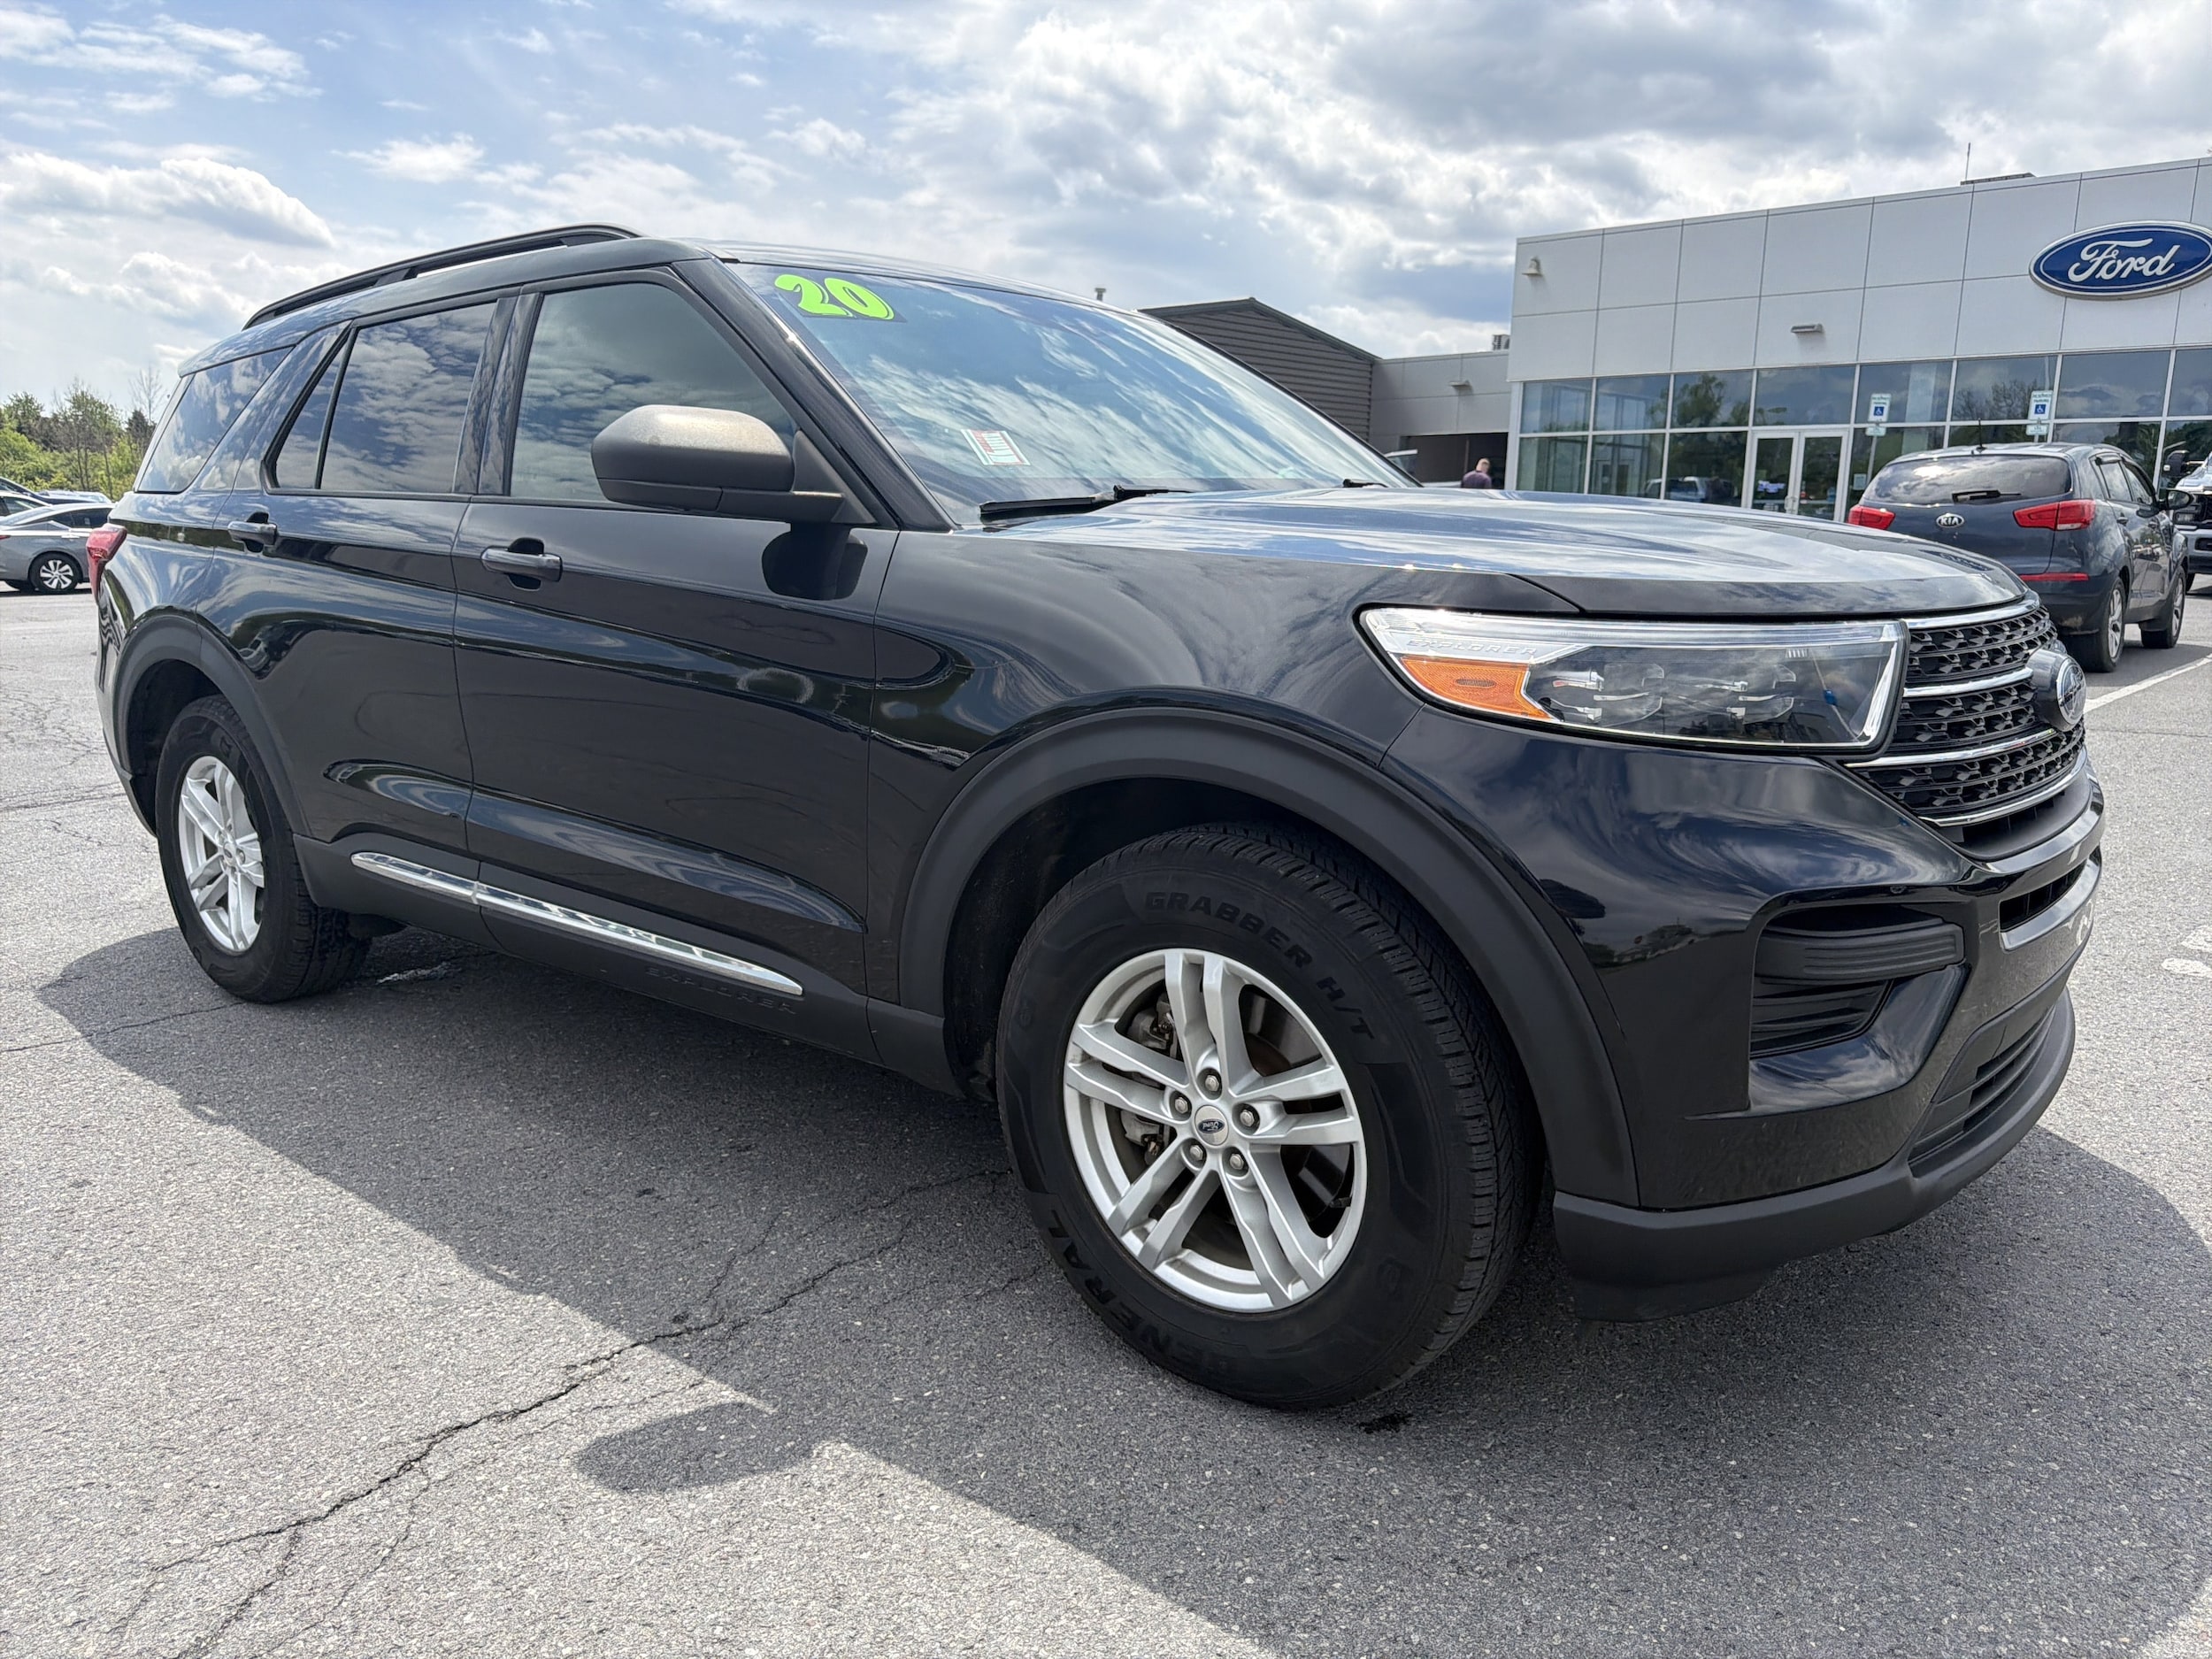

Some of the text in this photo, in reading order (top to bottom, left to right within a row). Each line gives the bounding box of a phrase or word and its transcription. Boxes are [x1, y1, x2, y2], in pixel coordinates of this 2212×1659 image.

[2067, 237, 2181, 282] Ford
[774, 273, 895, 320] 20
[1940, 516, 1960, 526] KIA
[1406, 639, 1538, 656] EXPLORER
[1145, 891, 1375, 1040] GRABBER H/T
